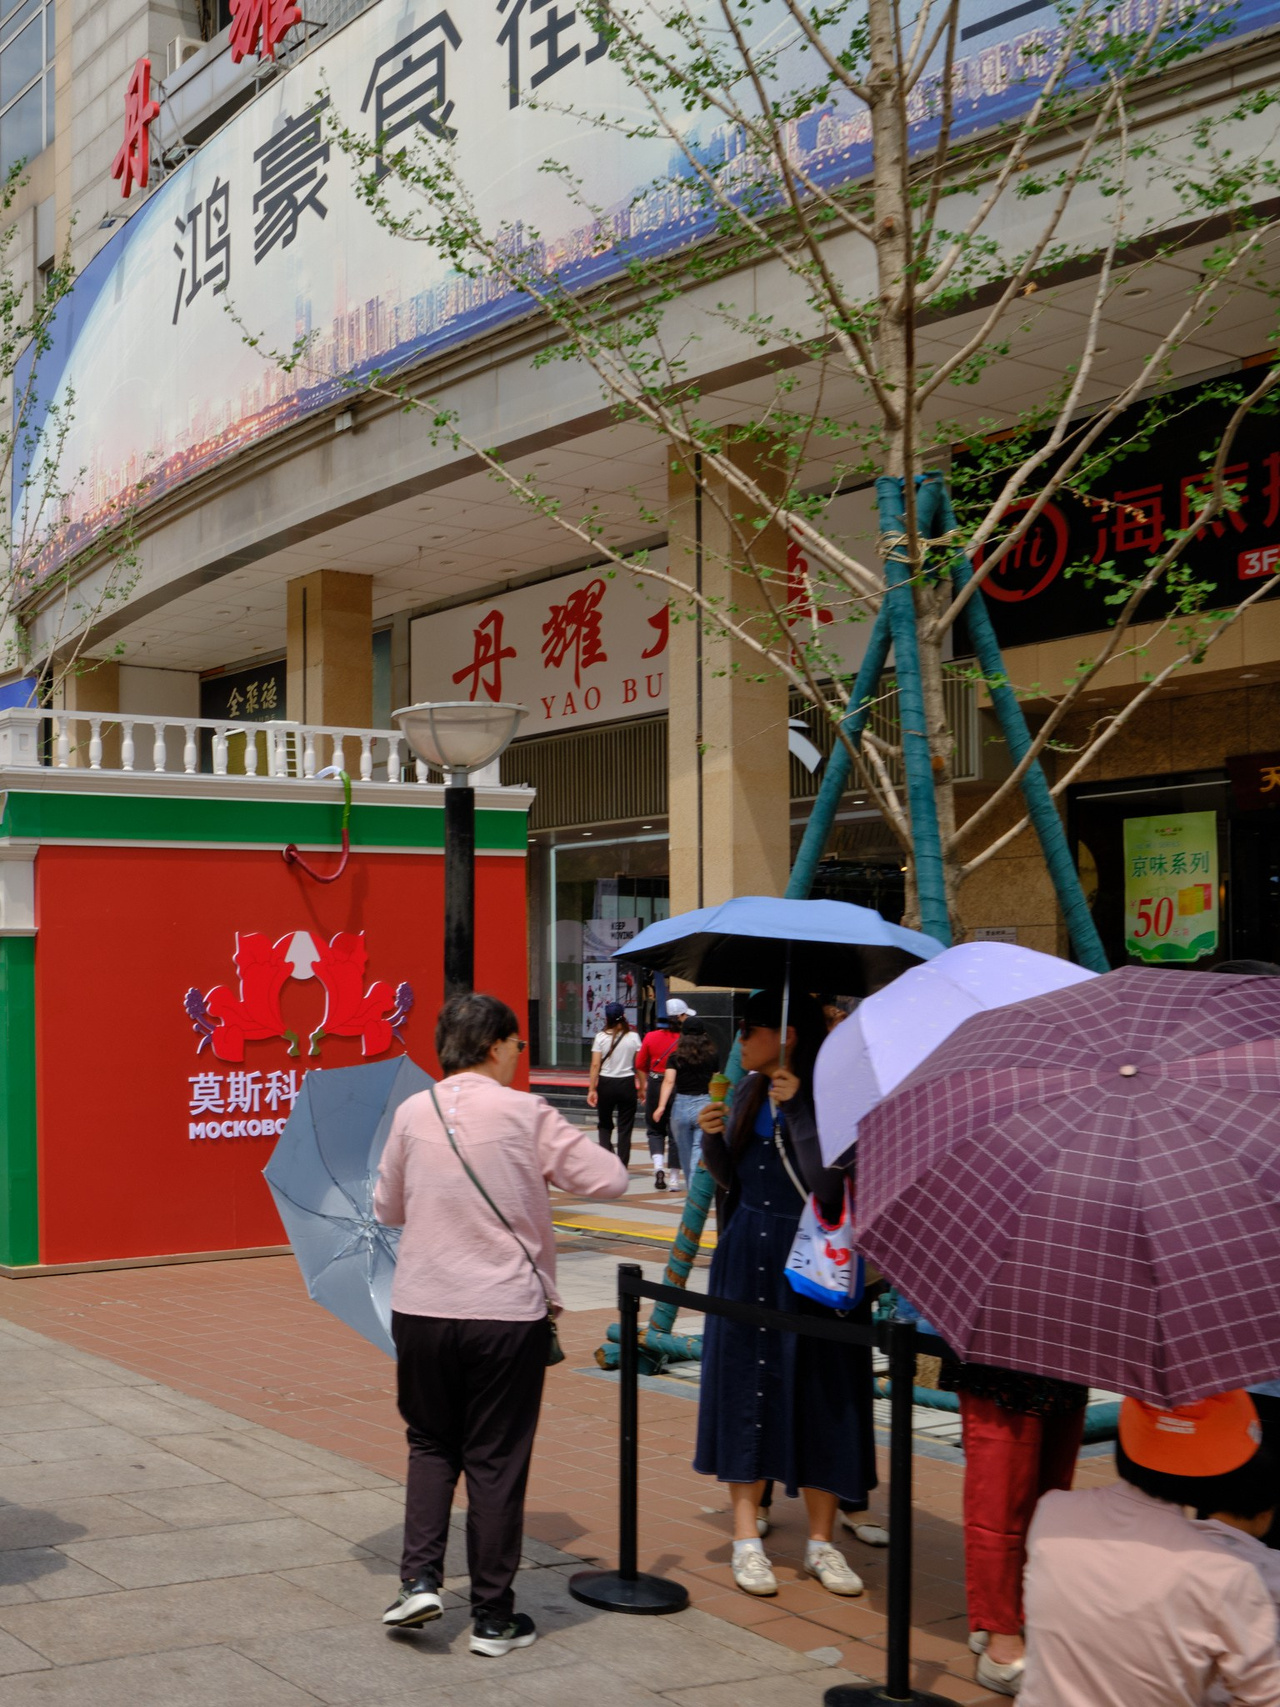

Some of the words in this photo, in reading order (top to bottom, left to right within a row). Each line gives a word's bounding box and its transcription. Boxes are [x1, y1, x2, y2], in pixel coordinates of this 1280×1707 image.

[541, 685, 602, 720] YAO
[1131, 851, 1211, 878] 京味系列
[610, 921, 626, 931] KEEP
[610, 931, 634, 940] MOVING
[188, 1069, 307, 1116] 莫斯科
